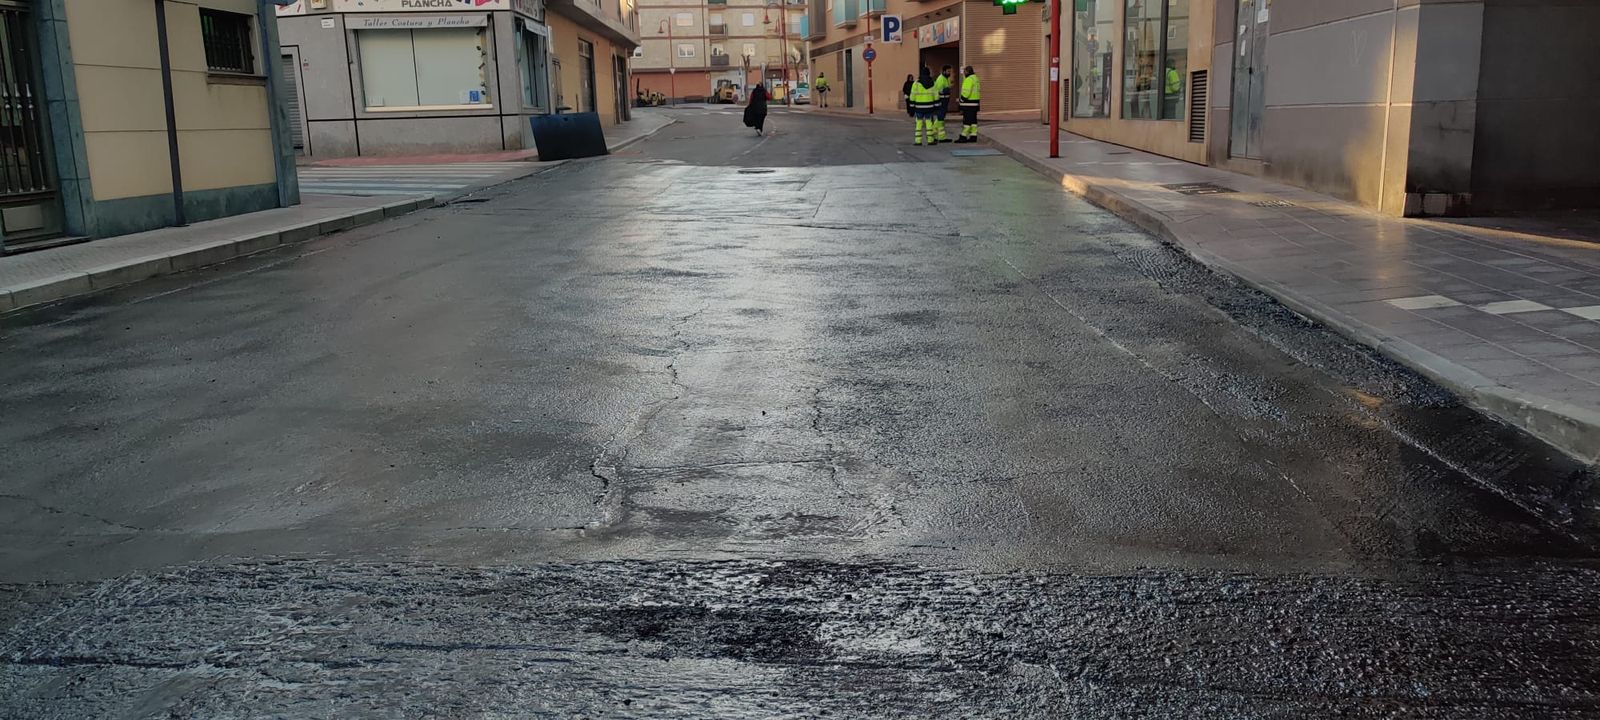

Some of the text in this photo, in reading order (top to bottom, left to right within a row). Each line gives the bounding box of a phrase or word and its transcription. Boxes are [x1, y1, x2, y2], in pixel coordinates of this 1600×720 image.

[363, 18, 388, 27] Taller
[391, 18, 423, 27] Costura
[437, 17, 470, 26] Plancha
[883, 16, 900, 42] P
